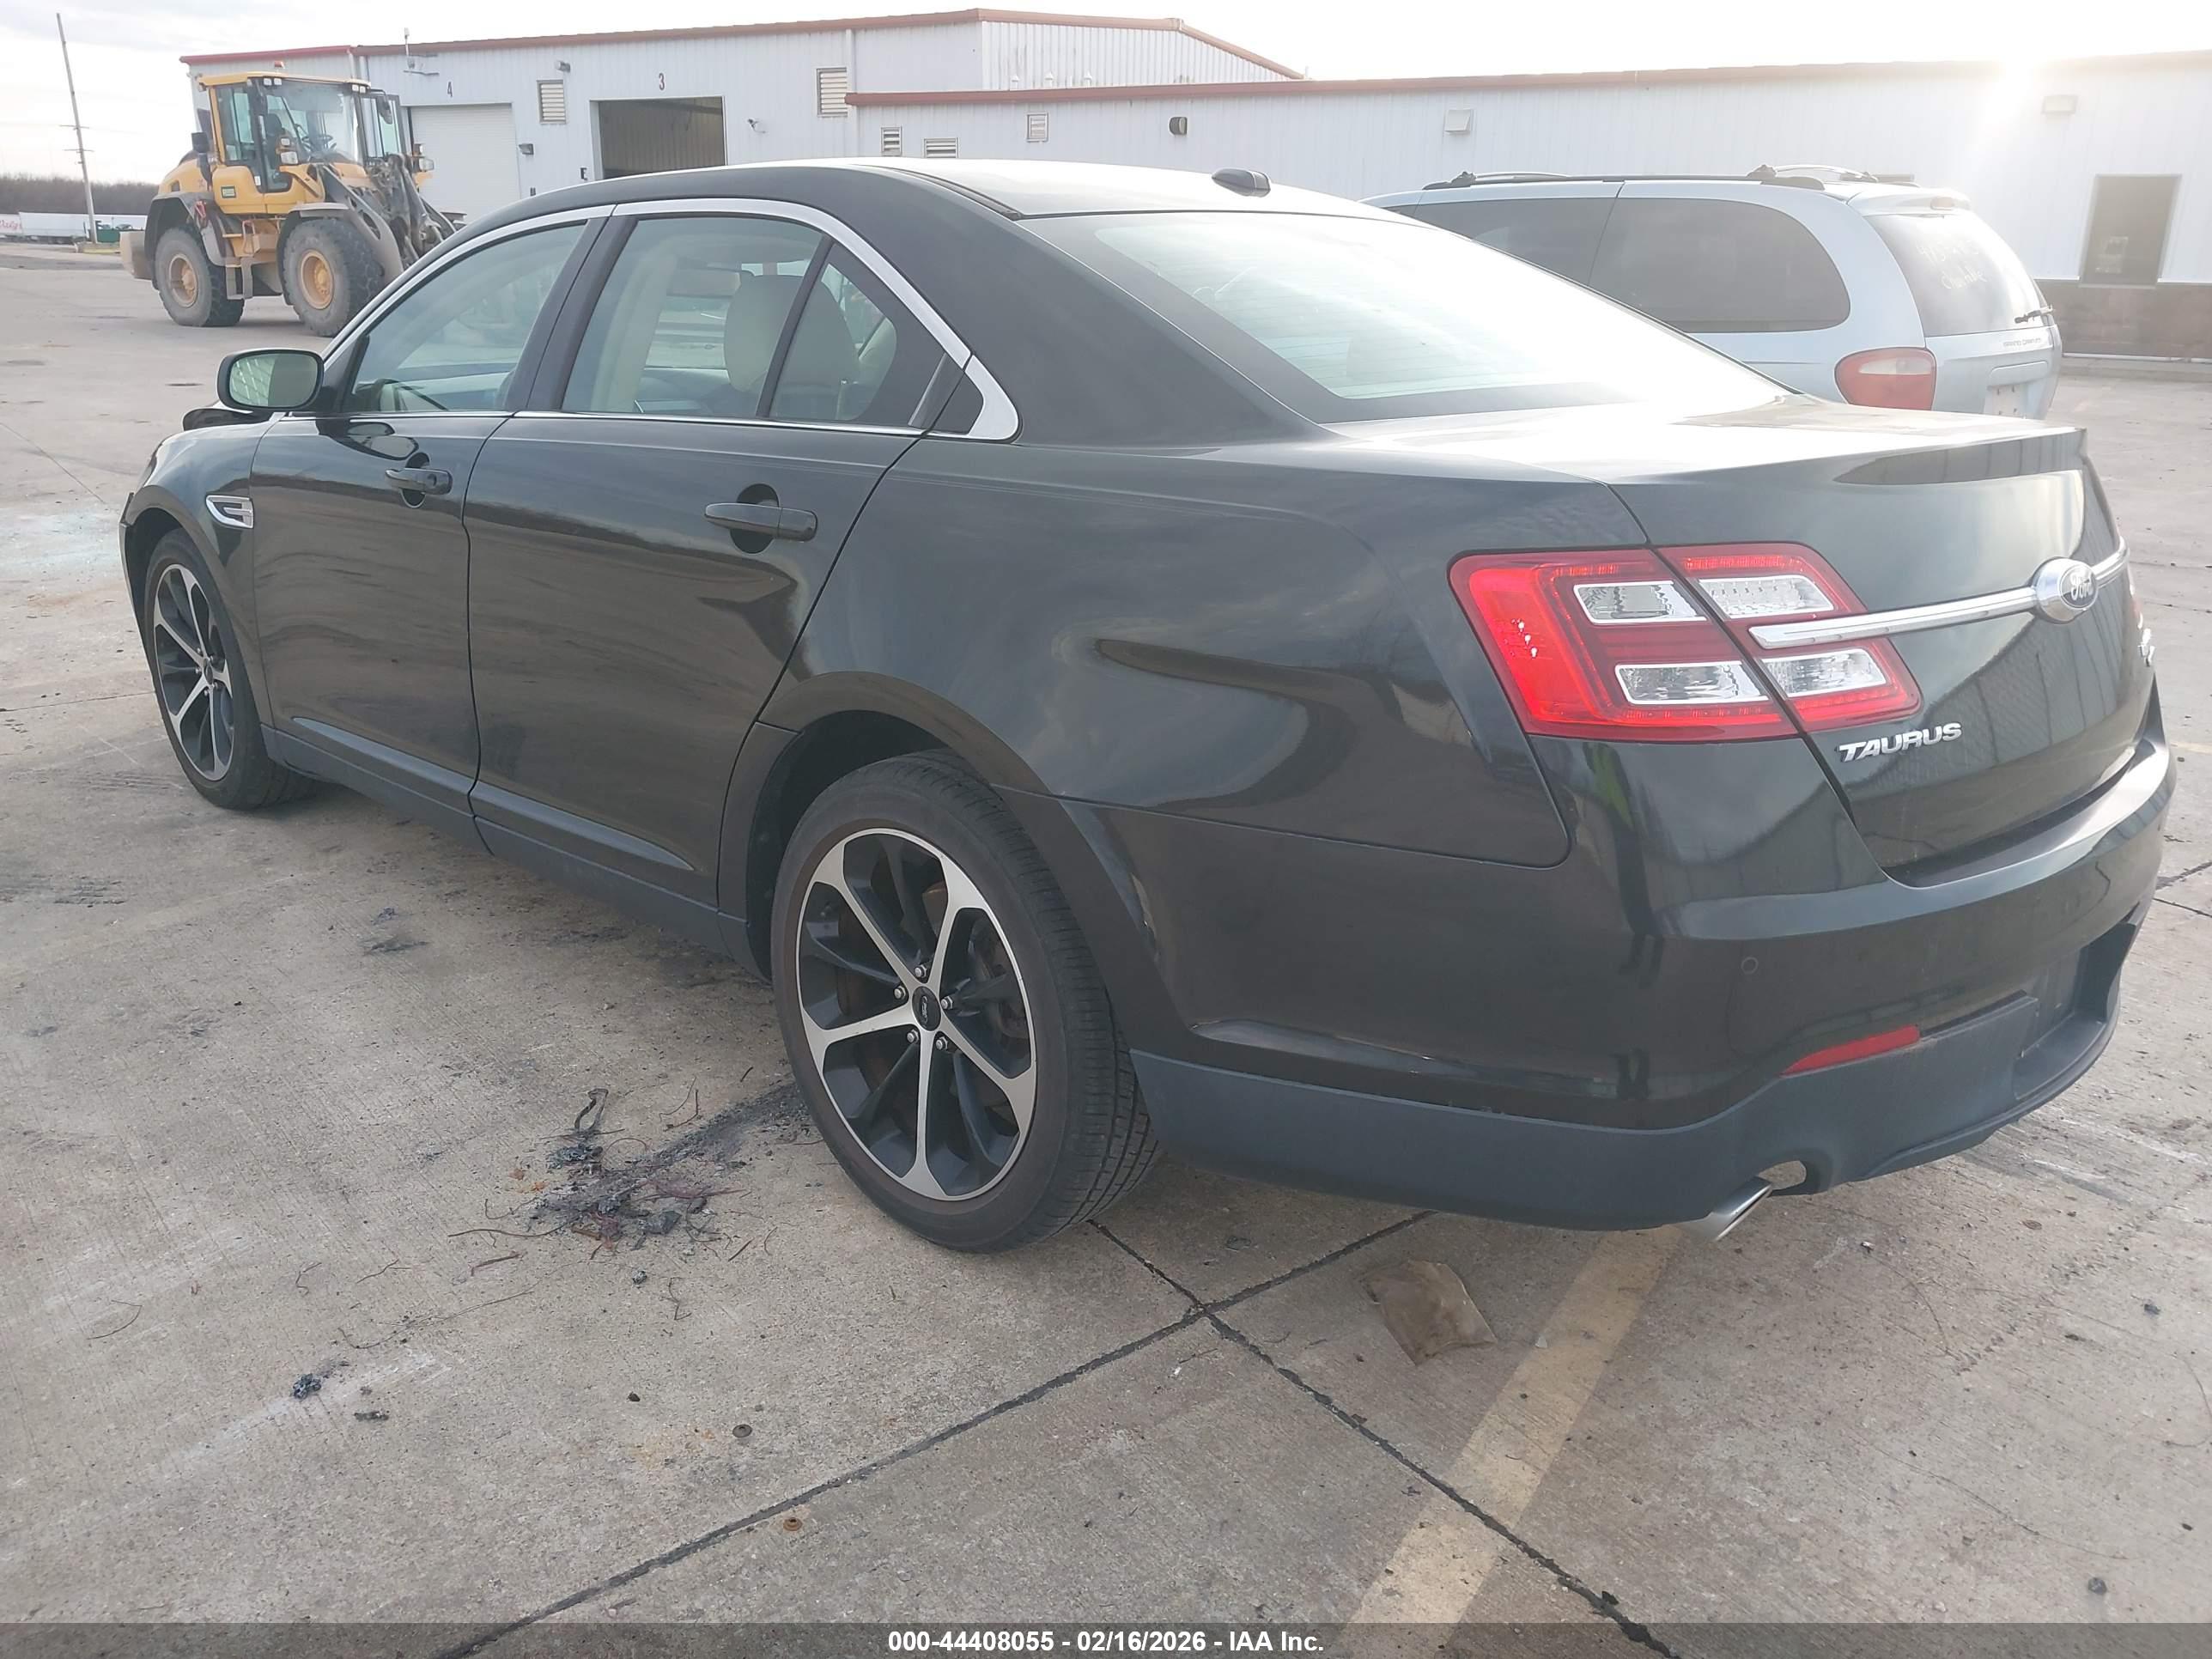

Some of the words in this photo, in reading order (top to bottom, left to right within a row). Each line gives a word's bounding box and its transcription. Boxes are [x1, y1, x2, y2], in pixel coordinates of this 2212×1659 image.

[447, 82, 453, 98] 4
[659, 73, 665, 90] 3
[1838, 722, 1962, 763] TAURUS
